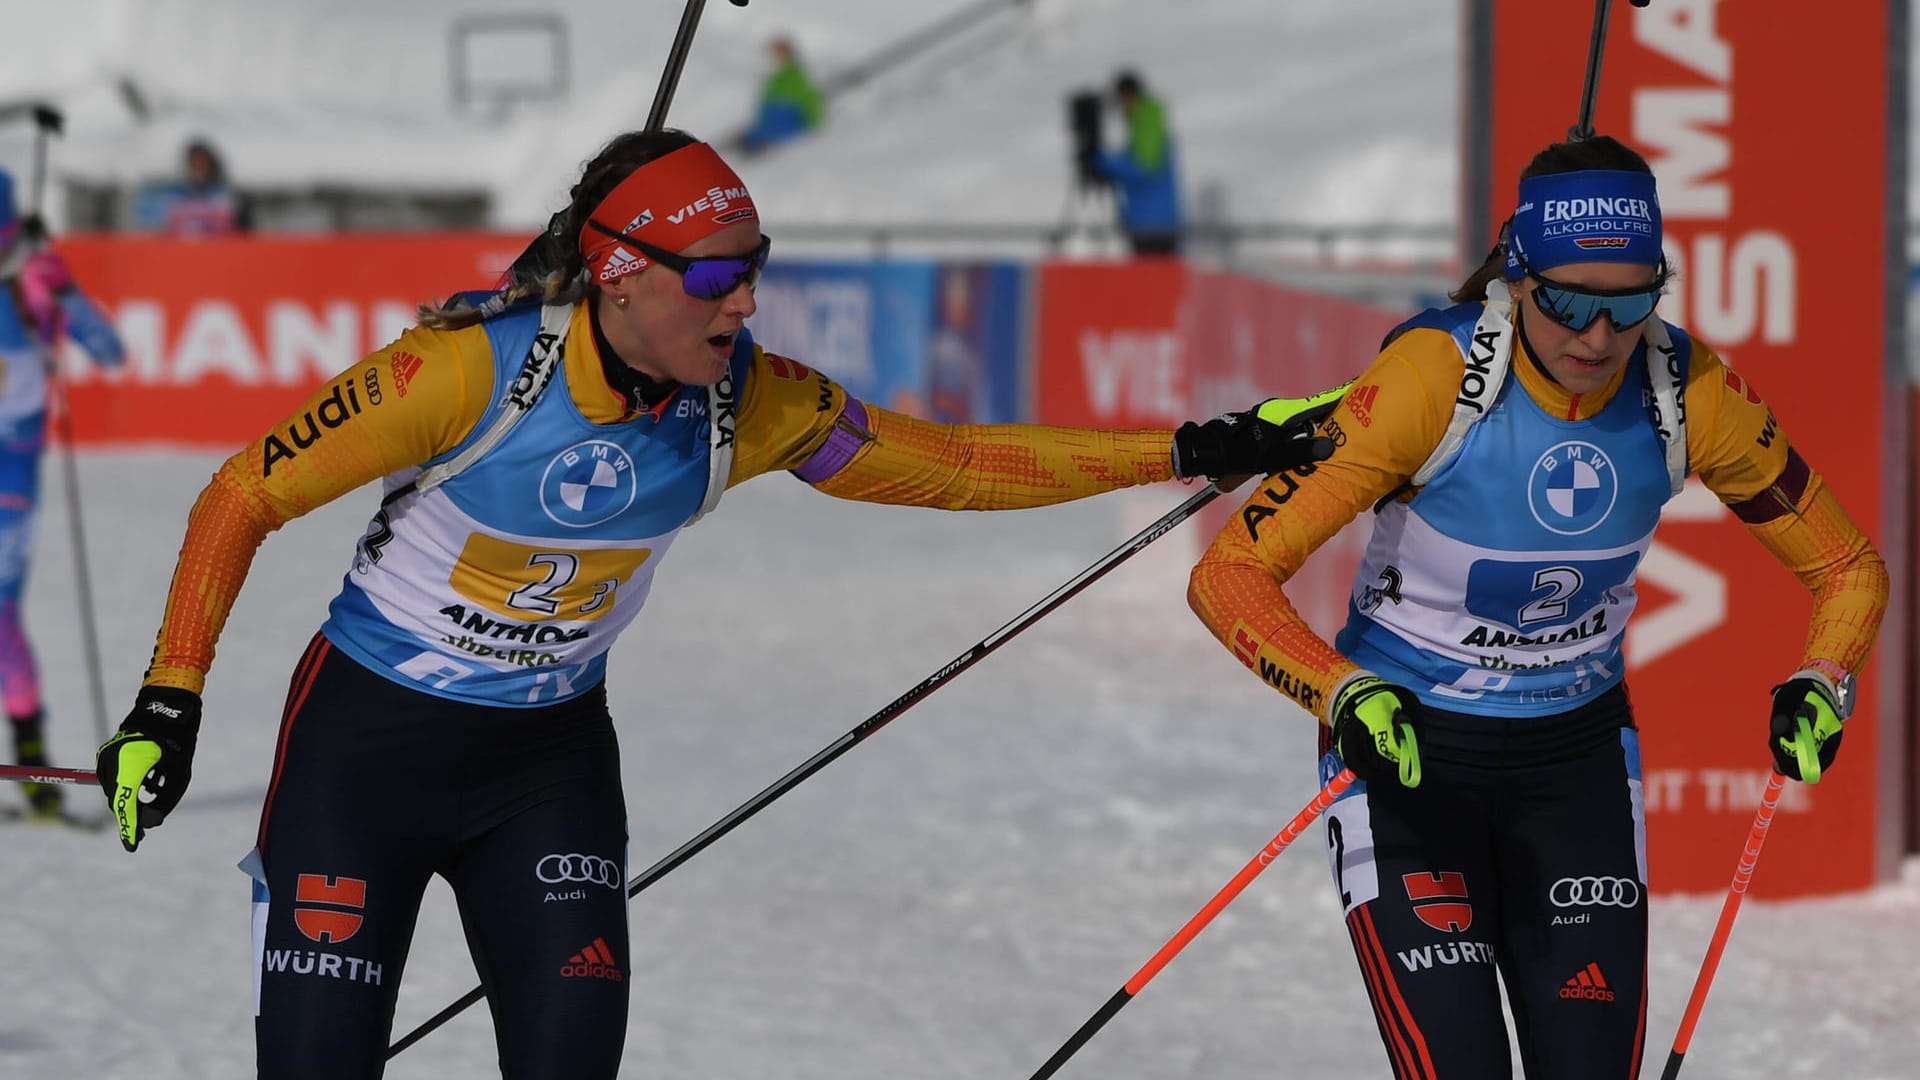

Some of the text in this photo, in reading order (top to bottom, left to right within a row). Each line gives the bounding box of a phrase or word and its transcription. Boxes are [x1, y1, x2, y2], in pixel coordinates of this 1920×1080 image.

[1544, 198, 1652, 222] ERDINGER
[600, 258, 648, 281] adidas
[1456, 331, 1501, 413] JOKA
[263, 379, 362, 478] Audi
[561, 443, 629, 473] BMW
[1542, 446, 1606, 471] BMW
[505, 552, 579, 616] 2
[1519, 566, 1585, 629] 2
[543, 888, 587, 904] Audi
[1550, 912, 1592, 926] Audi
[266, 948, 383, 987] WÜRTH
[1397, 940, 1497, 973] WÜRTH
[559, 961, 624, 983] adidas
[1558, 982, 1616, 1002] adidas
